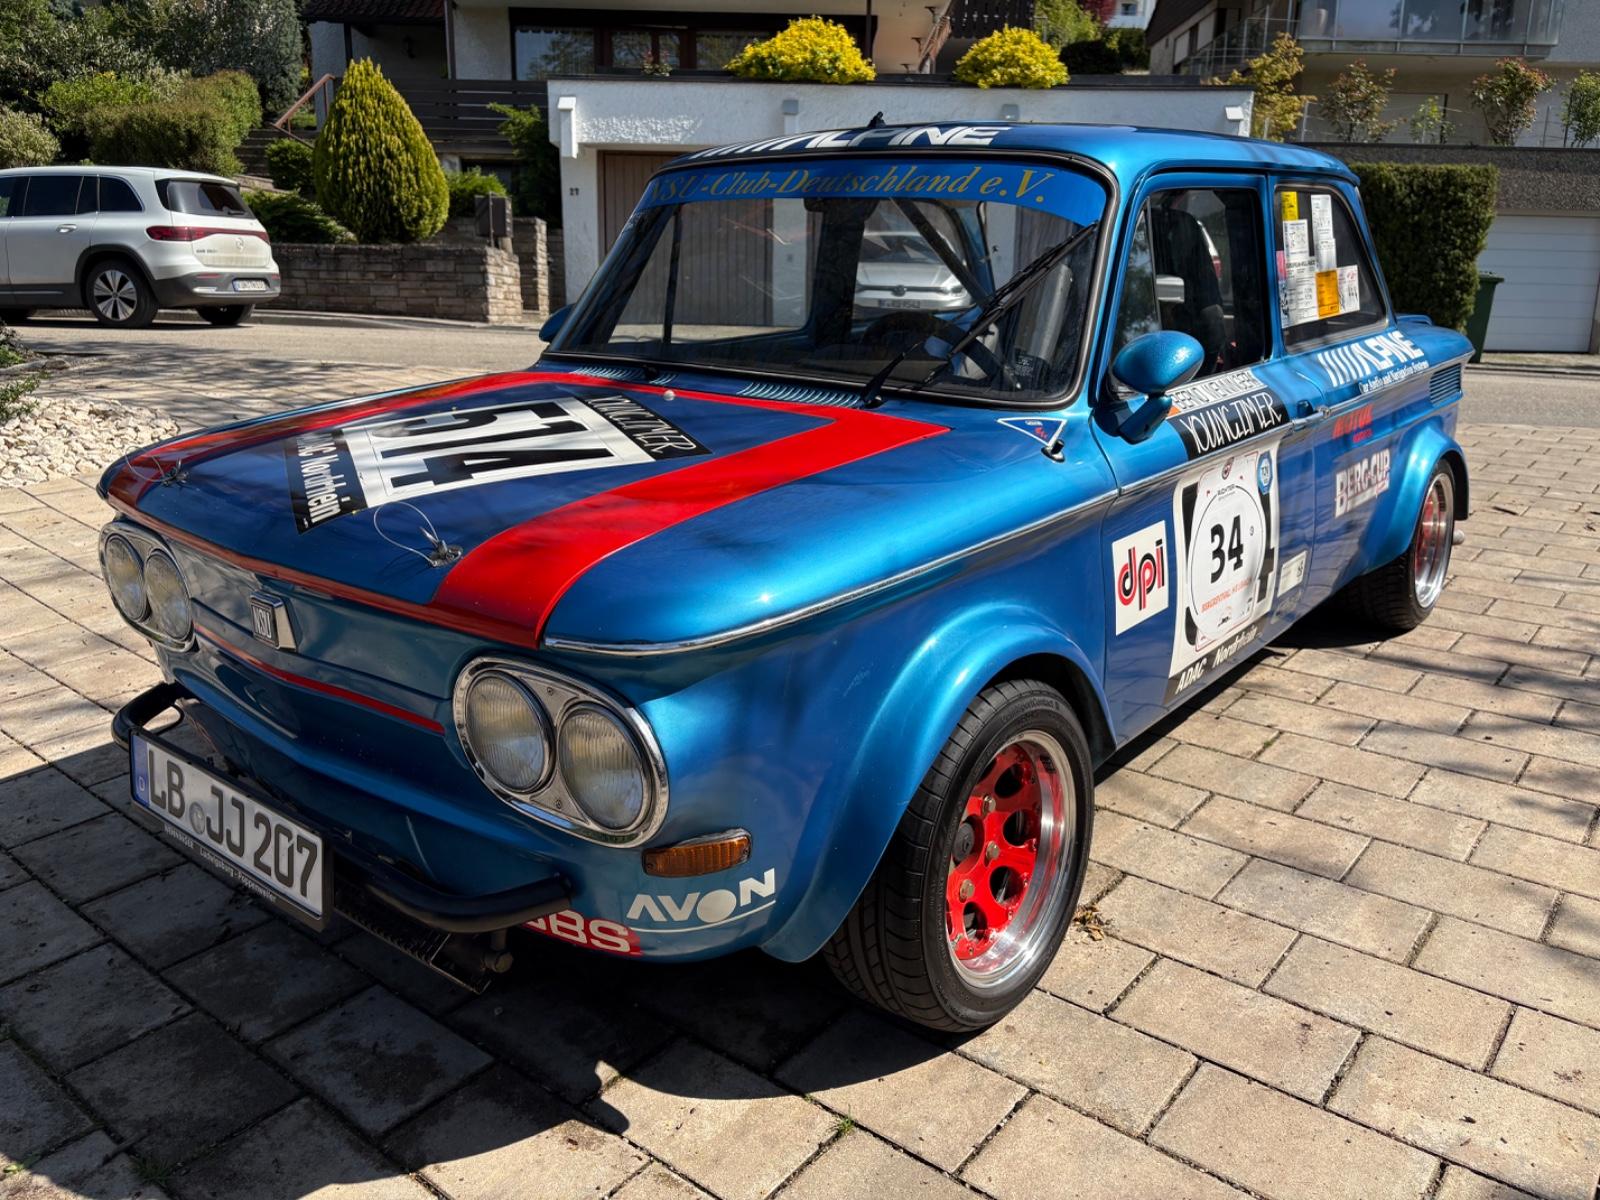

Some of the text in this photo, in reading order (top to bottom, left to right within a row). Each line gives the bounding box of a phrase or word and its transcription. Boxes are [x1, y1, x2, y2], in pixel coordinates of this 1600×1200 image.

[979, 169, 1055, 203] e.V.
[300, 454, 351, 524] Nordrhein
[1117, 539, 1165, 611] dpi
[1210, 514, 1244, 584] 34
[149, 750, 318, 898] LB JJ 207
[626, 867, 776, 924] AVON
[526, 909, 631, 953] BS
